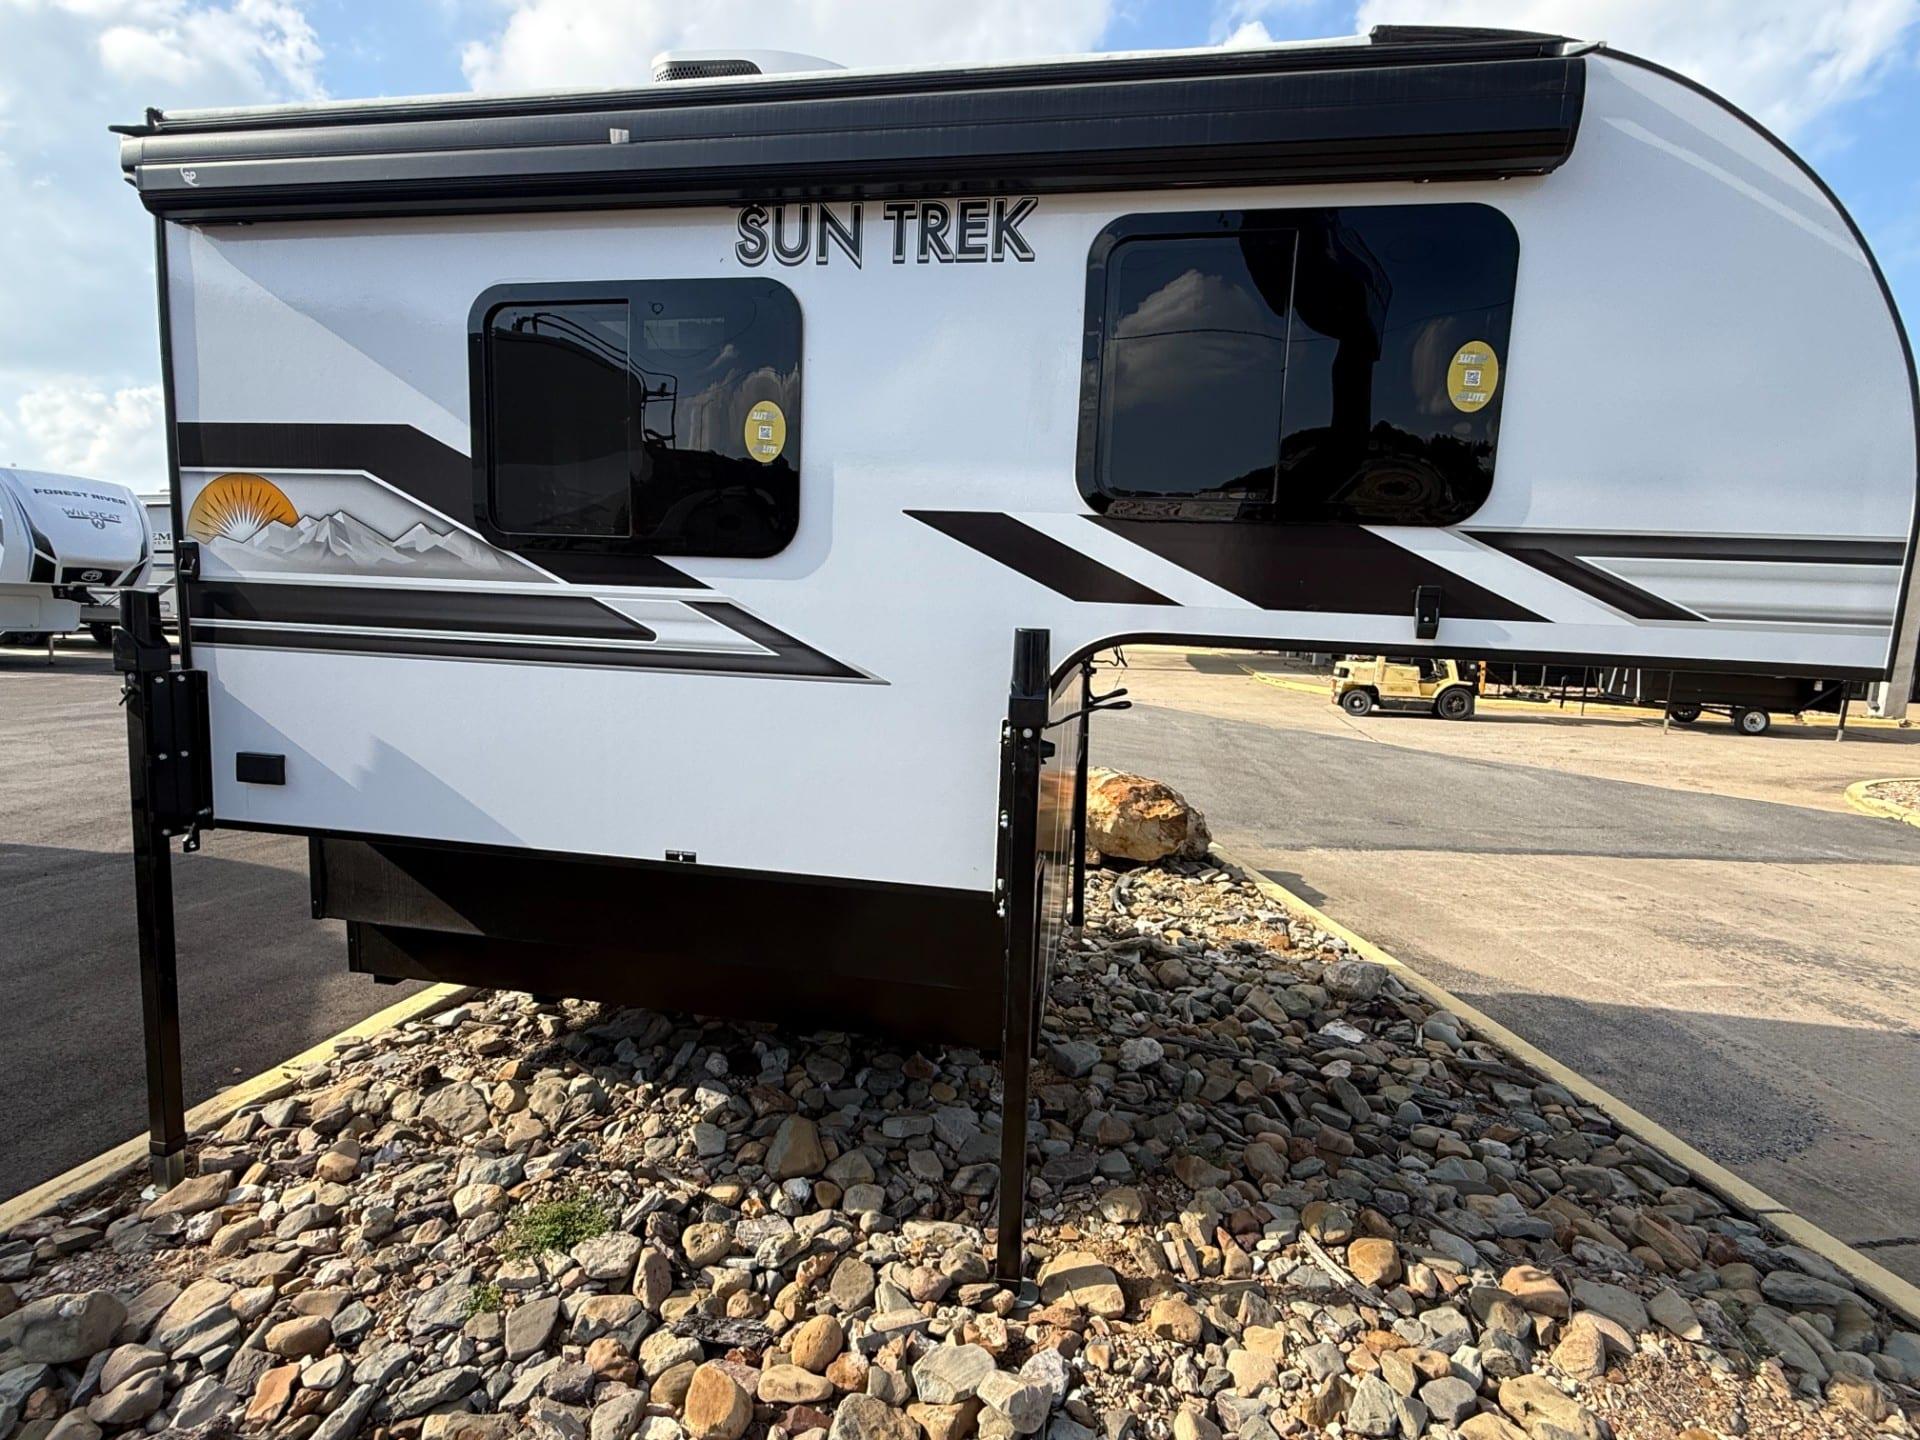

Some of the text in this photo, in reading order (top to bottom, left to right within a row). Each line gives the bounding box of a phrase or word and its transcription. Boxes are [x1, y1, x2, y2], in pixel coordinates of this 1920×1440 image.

[735, 198, 1038, 270] SUN TREK
[33, 488, 127, 505] FOREST RIVER
[62, 507, 121, 520] WILDCAT
